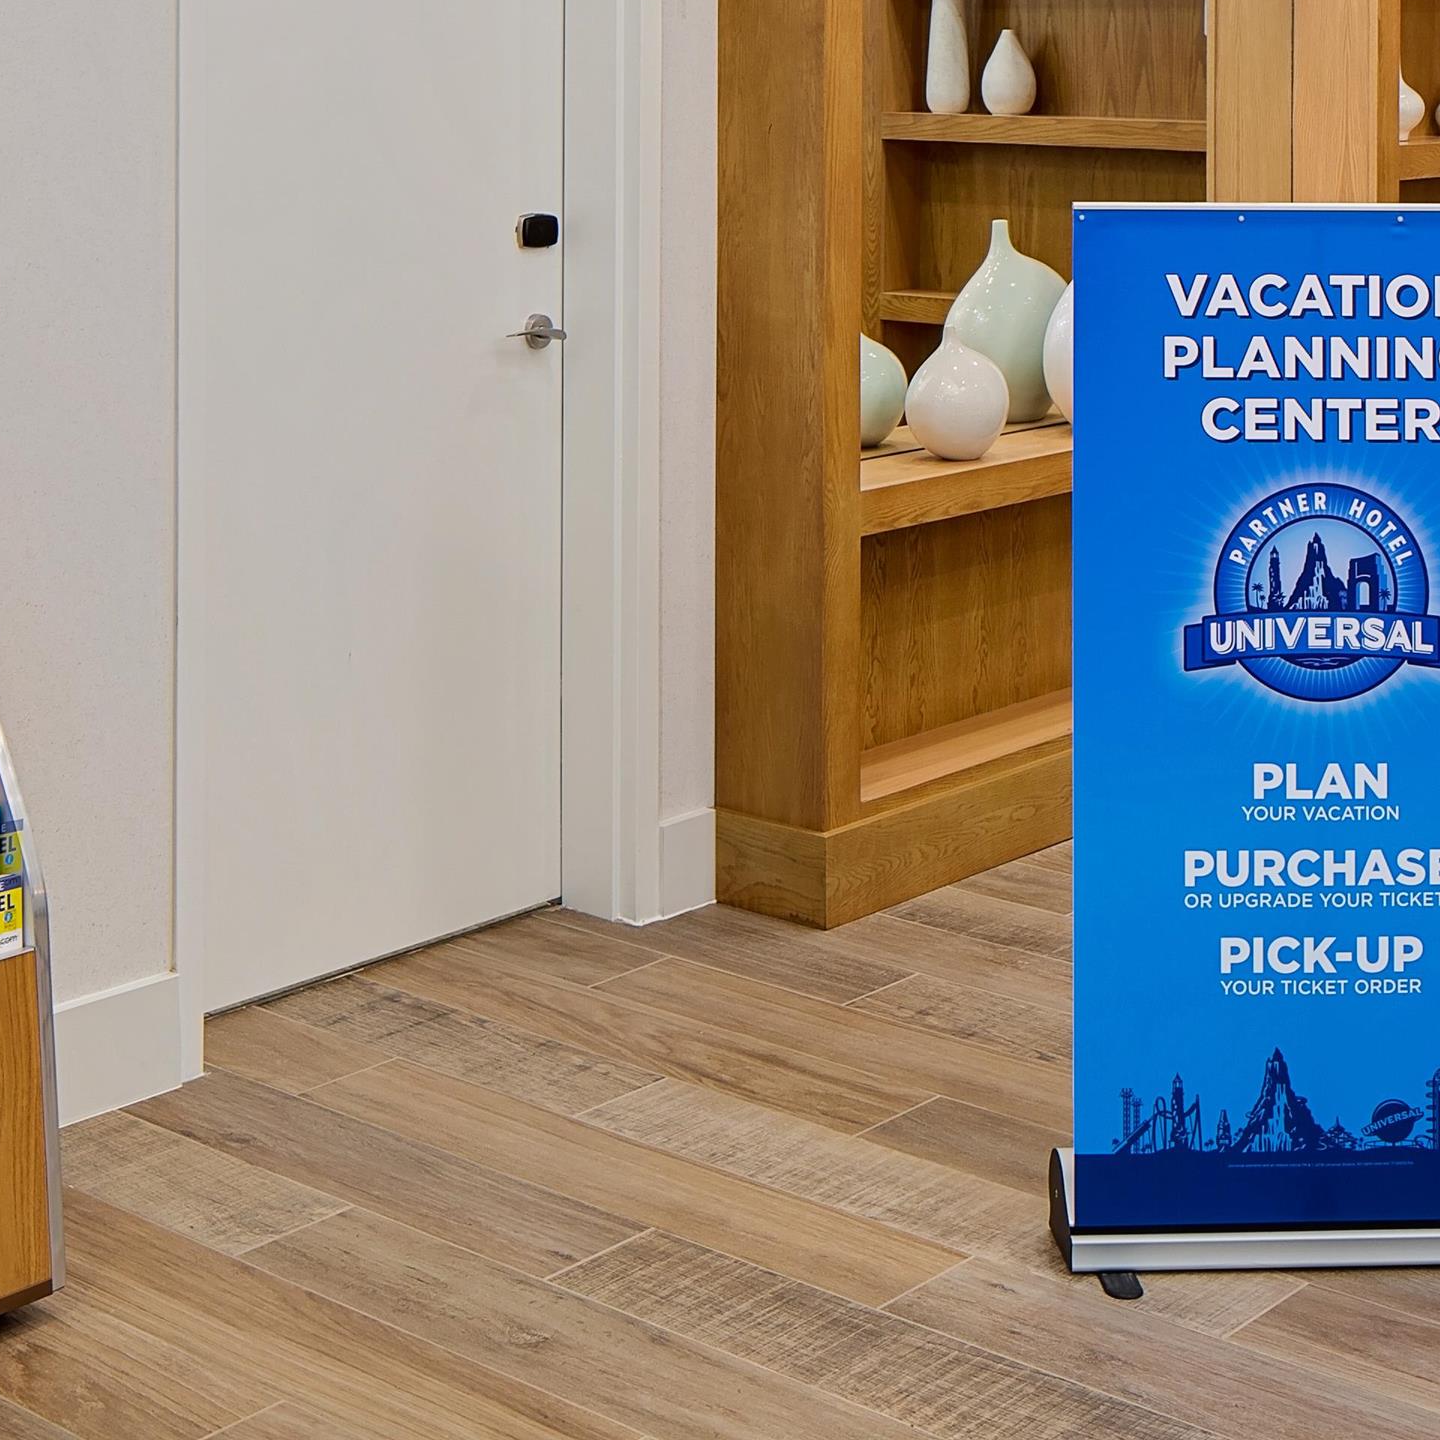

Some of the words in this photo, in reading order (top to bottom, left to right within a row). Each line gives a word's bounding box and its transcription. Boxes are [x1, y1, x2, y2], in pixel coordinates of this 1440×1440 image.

[1228, 492, 1327, 566] PARTNER
[1349, 498, 1413, 566] HOTEL
[1209, 616, 1434, 655] UNIVERSAL
[1253, 763, 1388, 800] PLAN
[1242, 805, 1296, 822] YOUR
[1302, 805, 1400, 821] VACATION
[1184, 892, 1212, 909] OR
[1218, 892, 1313, 909] UPGRADE
[1320, 892, 1372, 908] YOUR
[1220, 935, 1424, 974] PICK-UP
[1221, 980, 1274, 996] YOUR
[1281, 980, 1348, 995] TICKET
[1354, 979, 1422, 995] ORDER
[1362, 1107, 1424, 1136] UNIVERSAL
